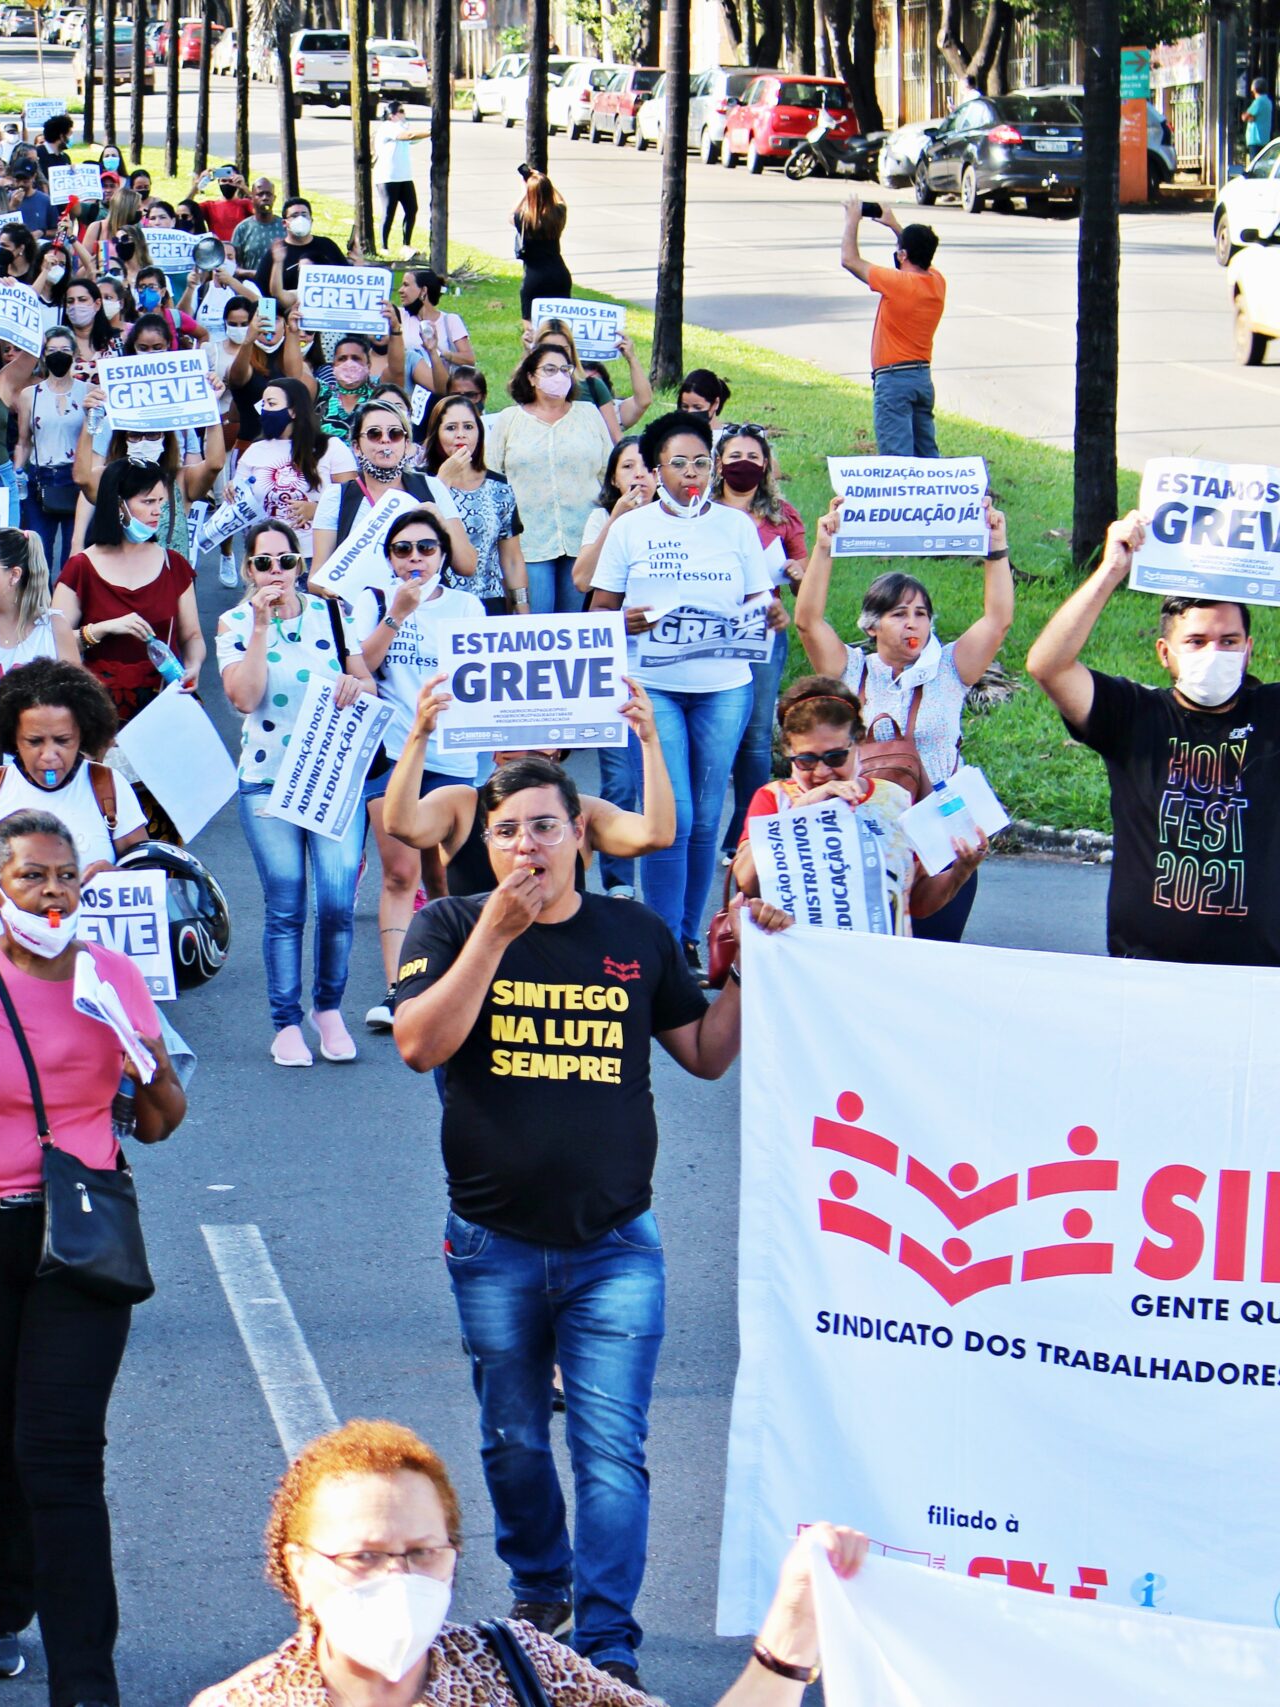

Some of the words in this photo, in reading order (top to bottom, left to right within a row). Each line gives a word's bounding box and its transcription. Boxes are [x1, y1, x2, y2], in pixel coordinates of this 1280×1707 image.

[53, 176, 99, 192] GREVE
[90, 165, 101, 174] EM
[146, 232, 190, 242] ESTAMOS
[306, 273, 363, 286] ESTAMOS
[367, 276, 385, 286] EM
[305, 286, 384, 311] GREVE
[538, 304, 597, 317] ESTAMOS
[600, 308, 617, 319] EM
[107, 360, 177, 381] ESTAMOS
[181, 359, 202, 373] EM
[110, 376, 208, 409] GREVE
[840, 466, 925, 481] VALORIZAÇÃO
[927, 467, 976, 479] DOS/AS
[1157, 473, 1280, 503] ESTAMOS
[845, 484, 980, 498] ADMINISTRATIVOS
[843, 508, 867, 524] DA
[869, 502, 955, 528] EDUCAÇÃO
[958, 502, 981, 525] JÁ!
[1151, 502, 1280, 553] GREV
[328, 497, 401, 582] QUINQUÊNIO
[648, 540, 681, 550] Lute
[649, 551, 689, 561] como
[650, 561, 682, 570] uma
[452, 629, 572, 656] ESTAMOS
[578, 627, 613, 649] EM
[651, 615, 767, 644] GREVE
[384, 653, 439, 669] profess
[452, 658, 616, 703] GREVE
[281, 731, 317, 809] VALORIZAÇÃO
[310, 686, 332, 731] DOS/AS
[298, 708, 343, 815] ADMINISTRATIV
[314, 803, 330, 824] DA
[326, 721, 357, 802] EDUCAÇÃO
[356, 700, 370, 723] JÁ!
[1167, 737, 1248, 796] HOLY
[821, 809, 838, 834] JÁ!
[1159, 790, 1249, 853] FEST
[768, 820, 788, 874] DOS/AS
[793, 816, 823, 926] NISTRATIVOS
[1153, 851, 1249, 916] 2021
[119, 886, 154, 908] EM
[77, 914, 158, 955] EVE
[491, 979, 629, 1012] SINTEGO
[491, 1014, 538, 1044] NA
[546, 1019, 623, 1049] LUTA
[490, 1049, 621, 1084] SEMPRE!
[1131, 1294, 1229, 1321] GENTE
[1241, 1300, 1280, 1323] QU
[816, 1311, 953, 1348] SINDICATO
[964, 1331, 1026, 1359] DOS
[1037, 1342, 1280, 1386] TRABALHADORE
[927, 1505, 997, 1531] filiado
[1006, 1514, 1019, 1533] à
